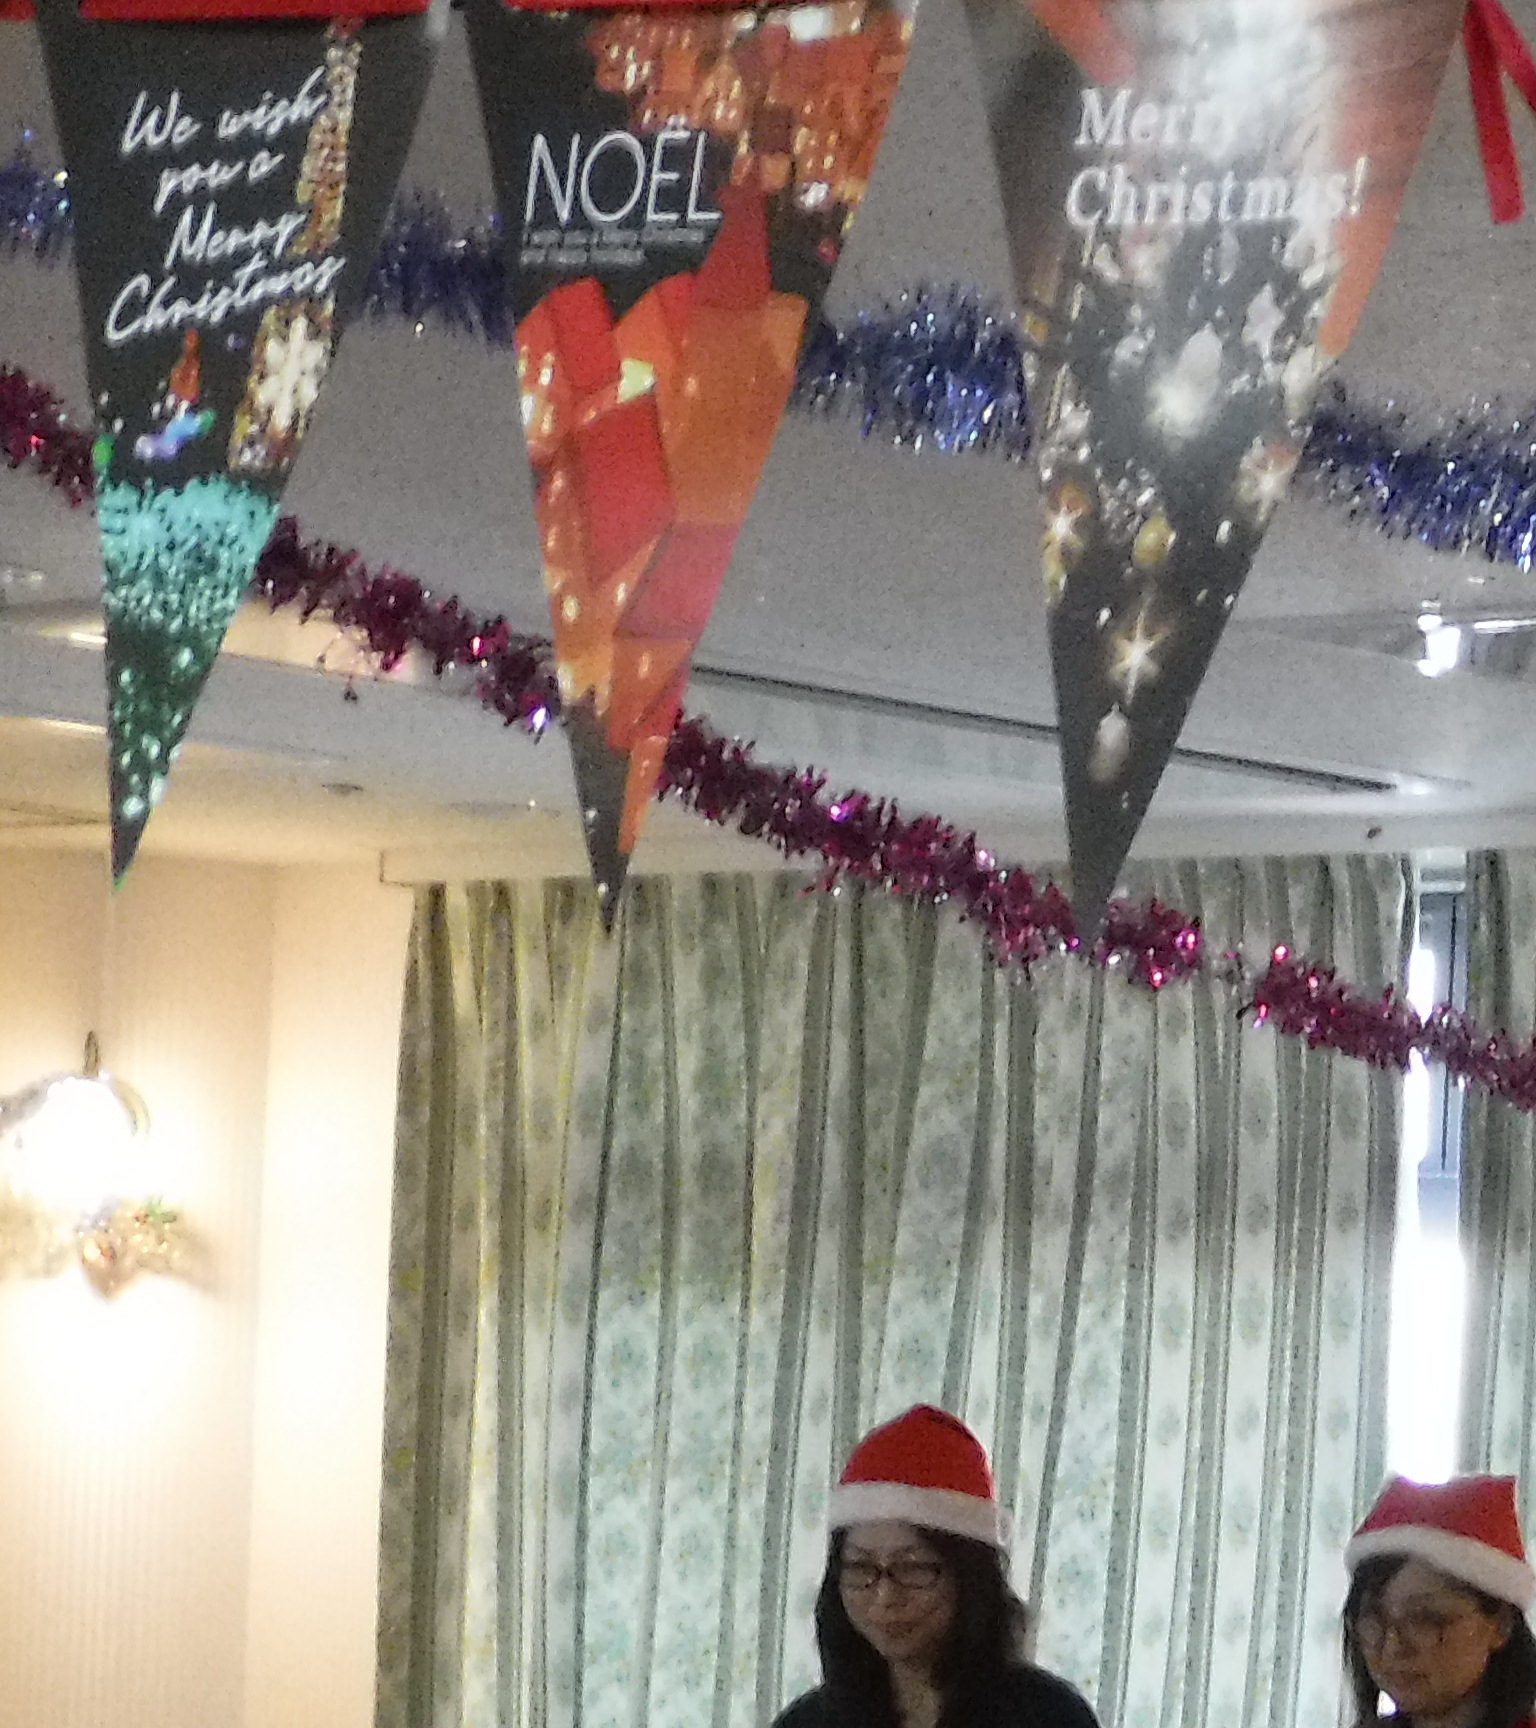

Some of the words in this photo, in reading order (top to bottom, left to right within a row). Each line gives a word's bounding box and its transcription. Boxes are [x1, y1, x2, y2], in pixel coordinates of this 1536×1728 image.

[121, 88, 202, 154] We
[216, 64, 328, 140] wish
[163, 200, 308, 270] Merry
[104, 252, 348, 344] Christmas
